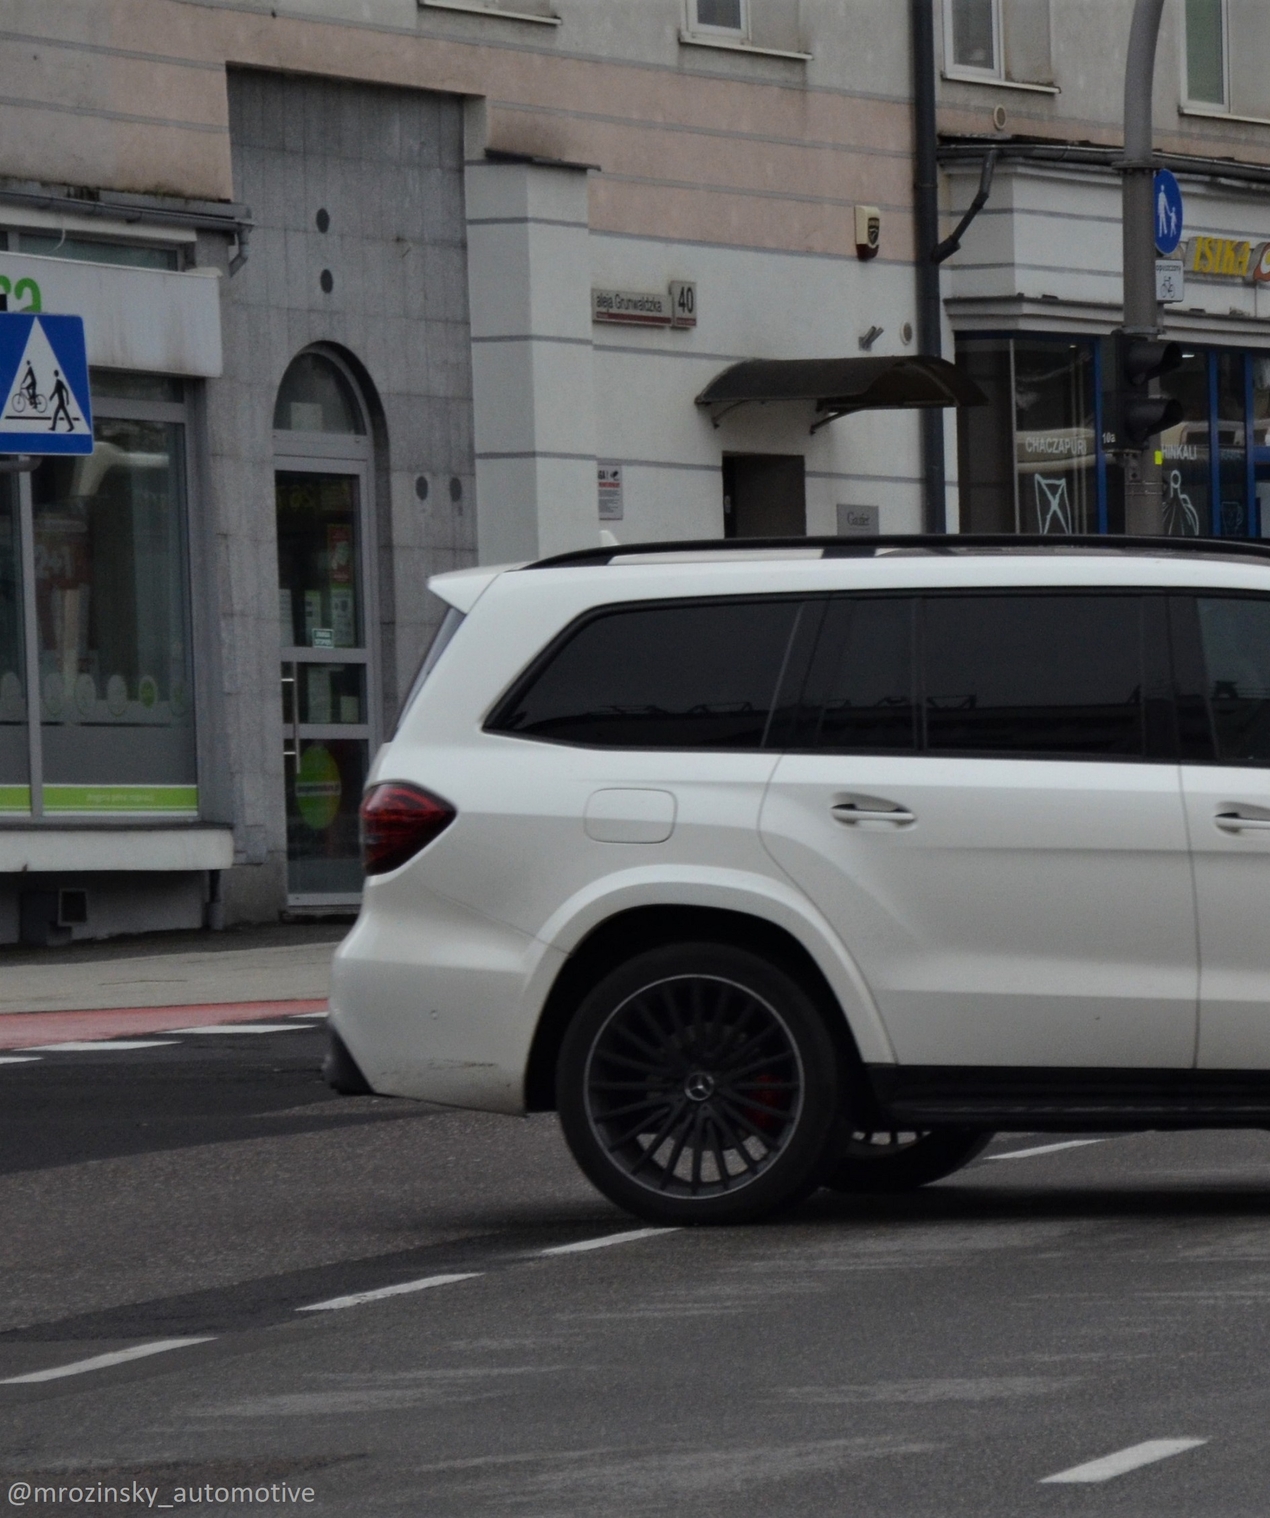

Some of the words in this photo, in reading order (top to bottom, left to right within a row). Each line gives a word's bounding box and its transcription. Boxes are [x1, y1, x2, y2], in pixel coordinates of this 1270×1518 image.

[596, 293, 614, 312] aleja
[615, 294, 663, 313] Grunwaldzka
[678, 286, 694, 313] 40
[1025, 436, 1087, 455] CHACZAPURI
[1102, 432, 1116, 444] 10a
[1161, 444, 1197, 460] HINKALI
